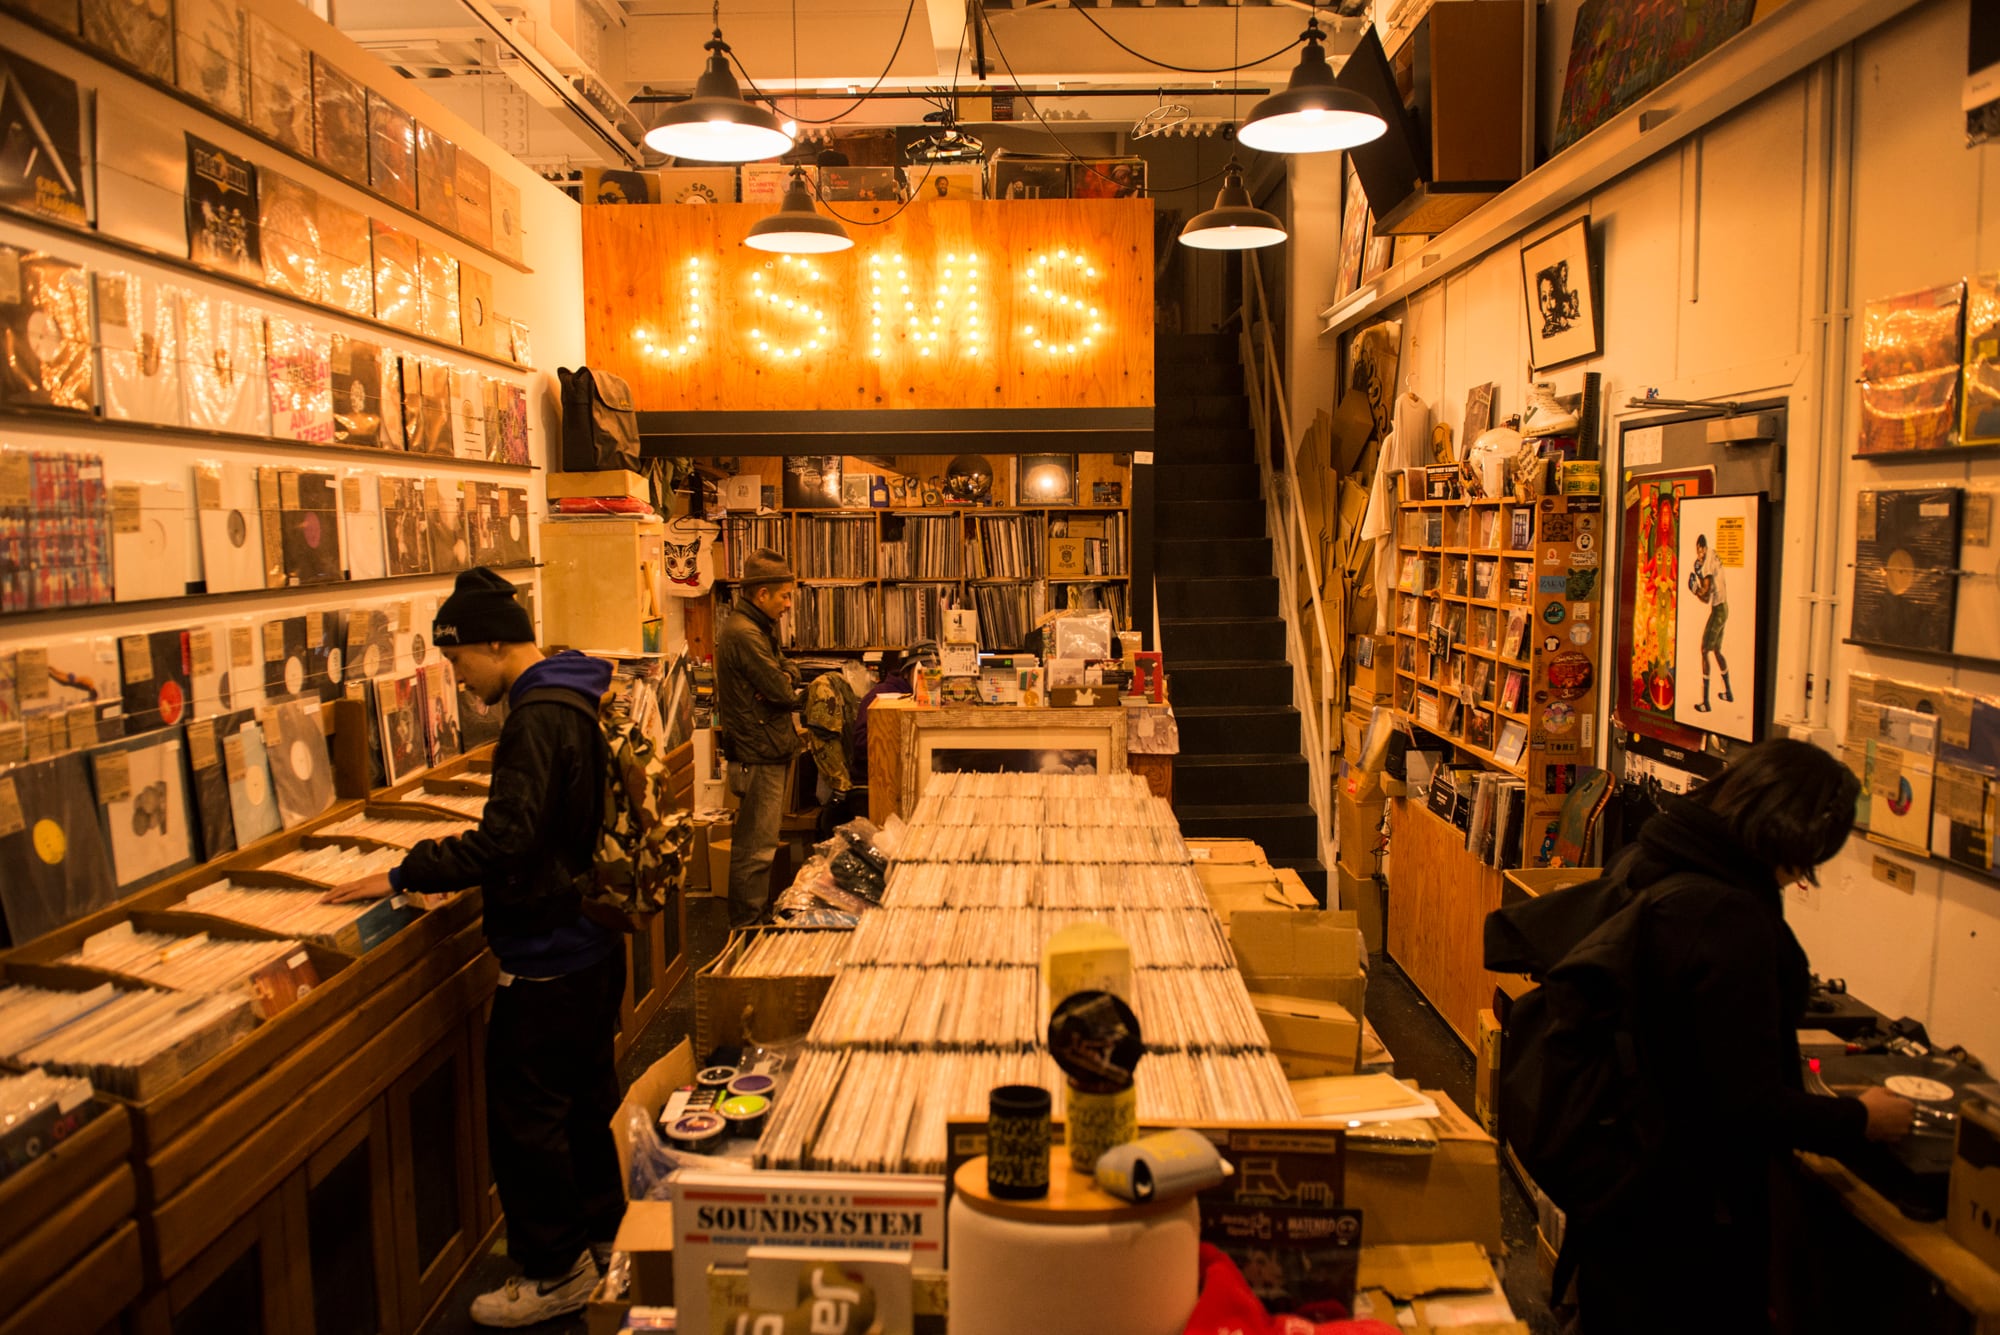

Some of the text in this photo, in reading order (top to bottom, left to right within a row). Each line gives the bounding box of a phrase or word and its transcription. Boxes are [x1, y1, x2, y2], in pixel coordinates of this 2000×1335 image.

[634, 250, 1104, 358] JSMS
[770, 1193, 847, 1206] REGGAE
[697, 1205, 923, 1236] SOUNDSYSTEM
